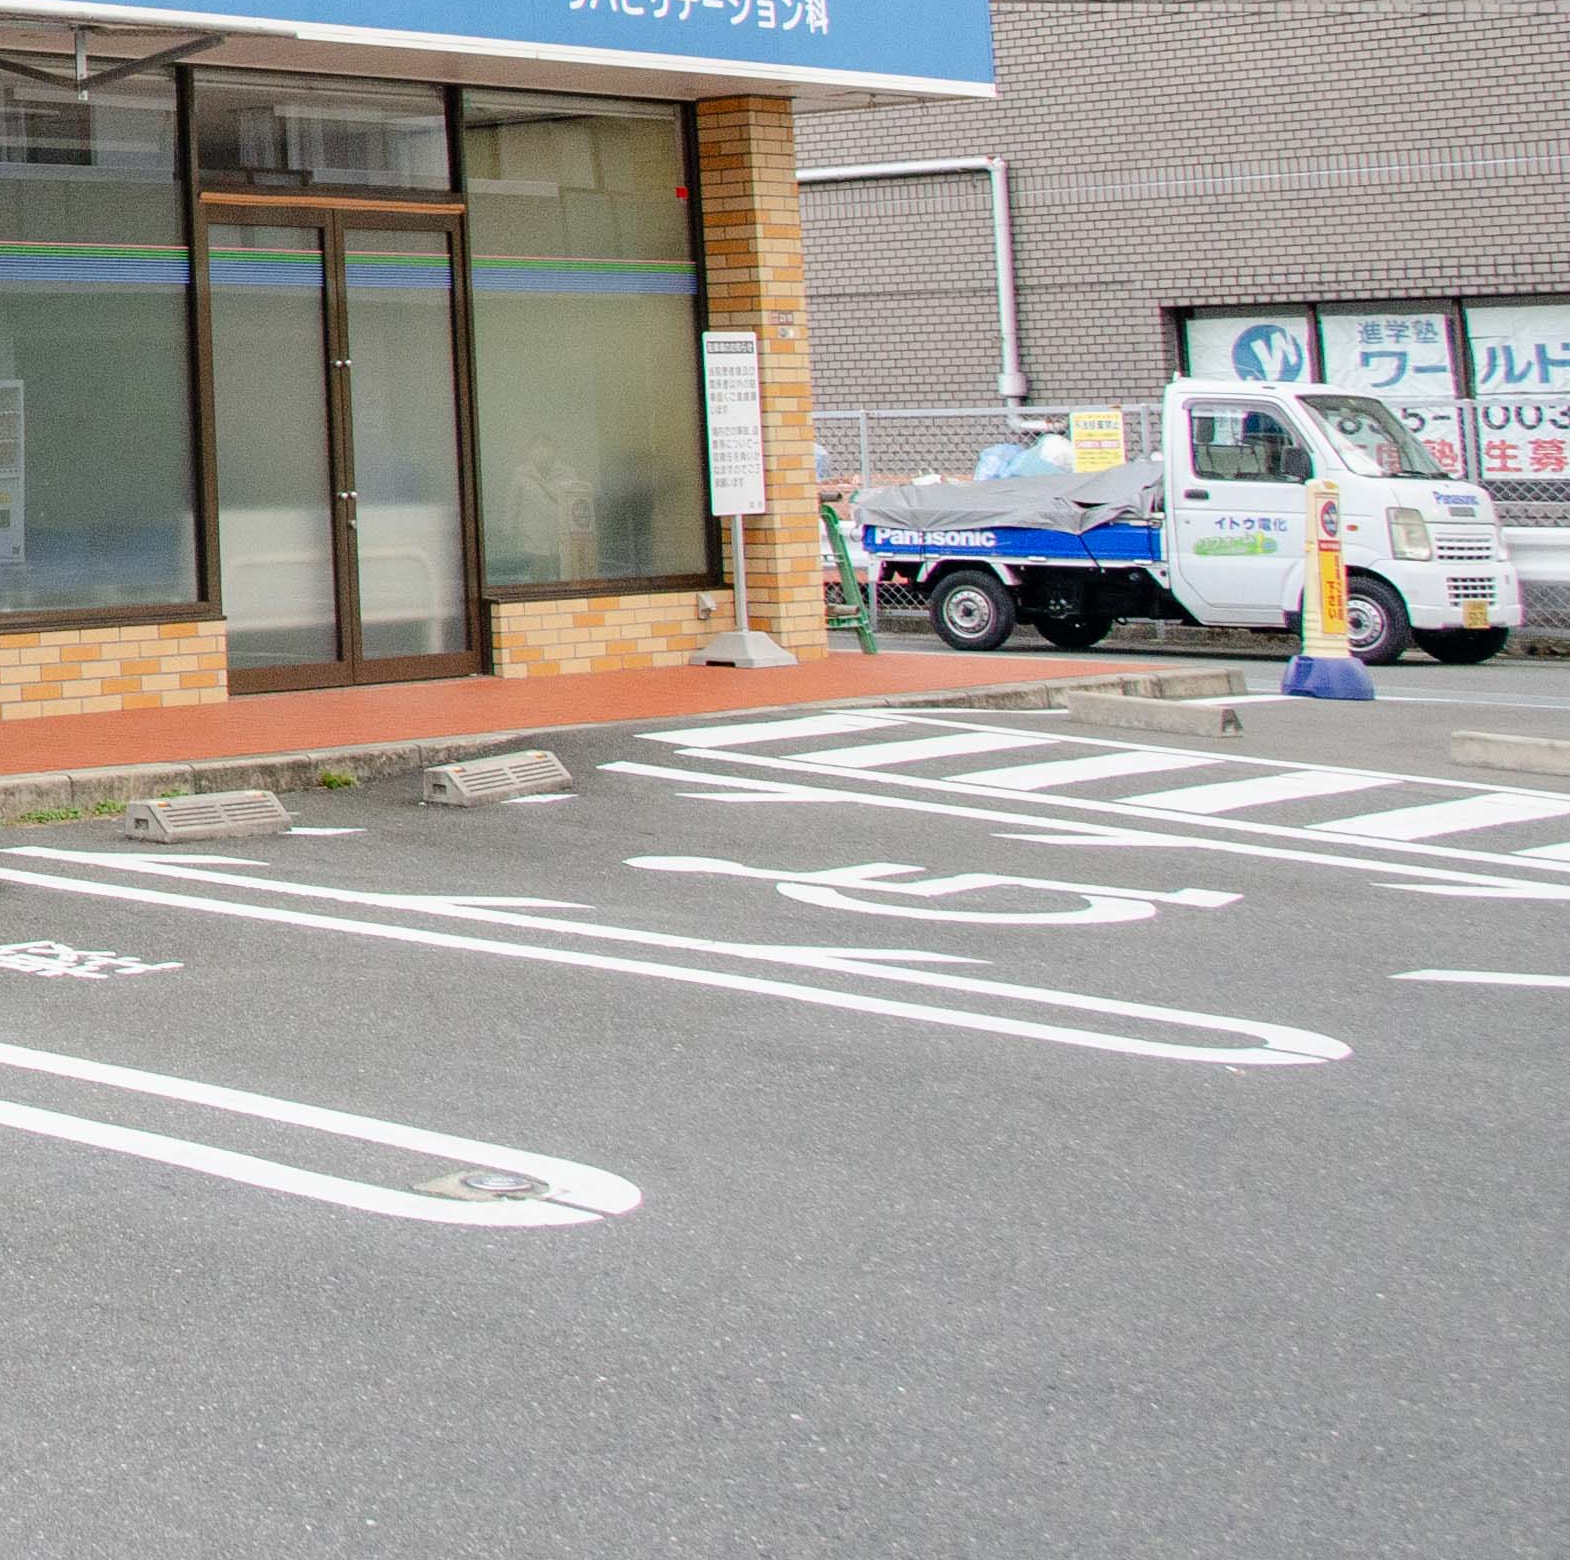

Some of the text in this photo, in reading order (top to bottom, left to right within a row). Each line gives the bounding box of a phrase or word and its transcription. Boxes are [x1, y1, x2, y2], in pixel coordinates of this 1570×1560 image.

[1357, 320, 1438, 344] 進学塾
[1213, 517, 1289, 532] イトウ電化
[874, 527, 997, 547] Panasonic
